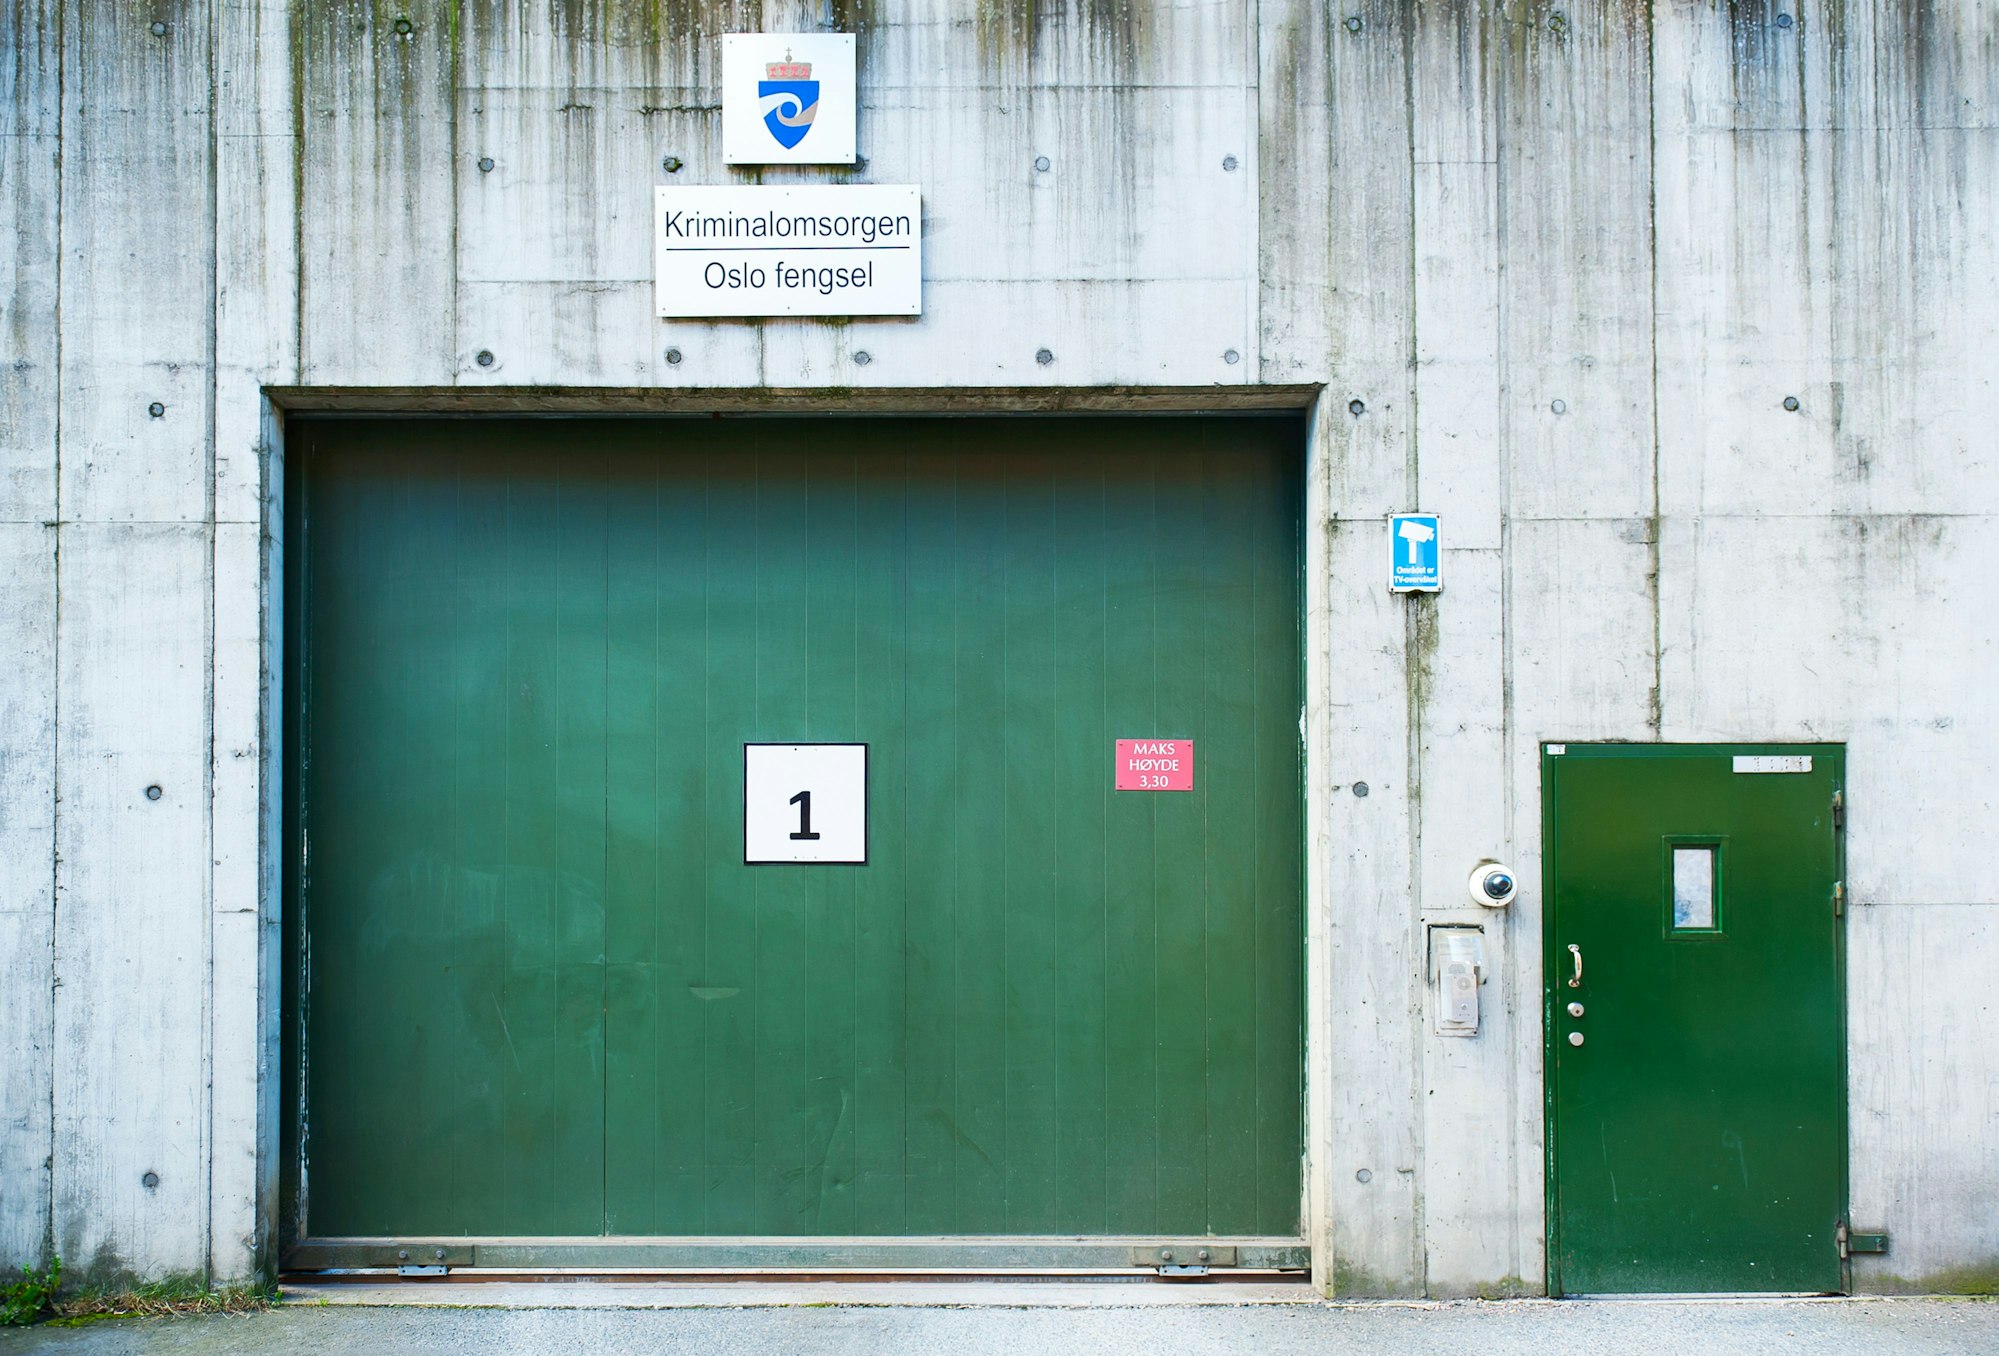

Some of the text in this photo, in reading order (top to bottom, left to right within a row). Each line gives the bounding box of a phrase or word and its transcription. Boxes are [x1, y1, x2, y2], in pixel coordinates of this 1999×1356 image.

[665, 210, 911, 243] Kriminalomsorgen
[704, 260, 873, 295] Oslo fengsel
[1133, 743, 1175, 755] MAKS
[1129, 758, 1179, 771] HØYDE
[1139, 775, 1169, 789] 3,30
[789, 790, 820, 840] 1
